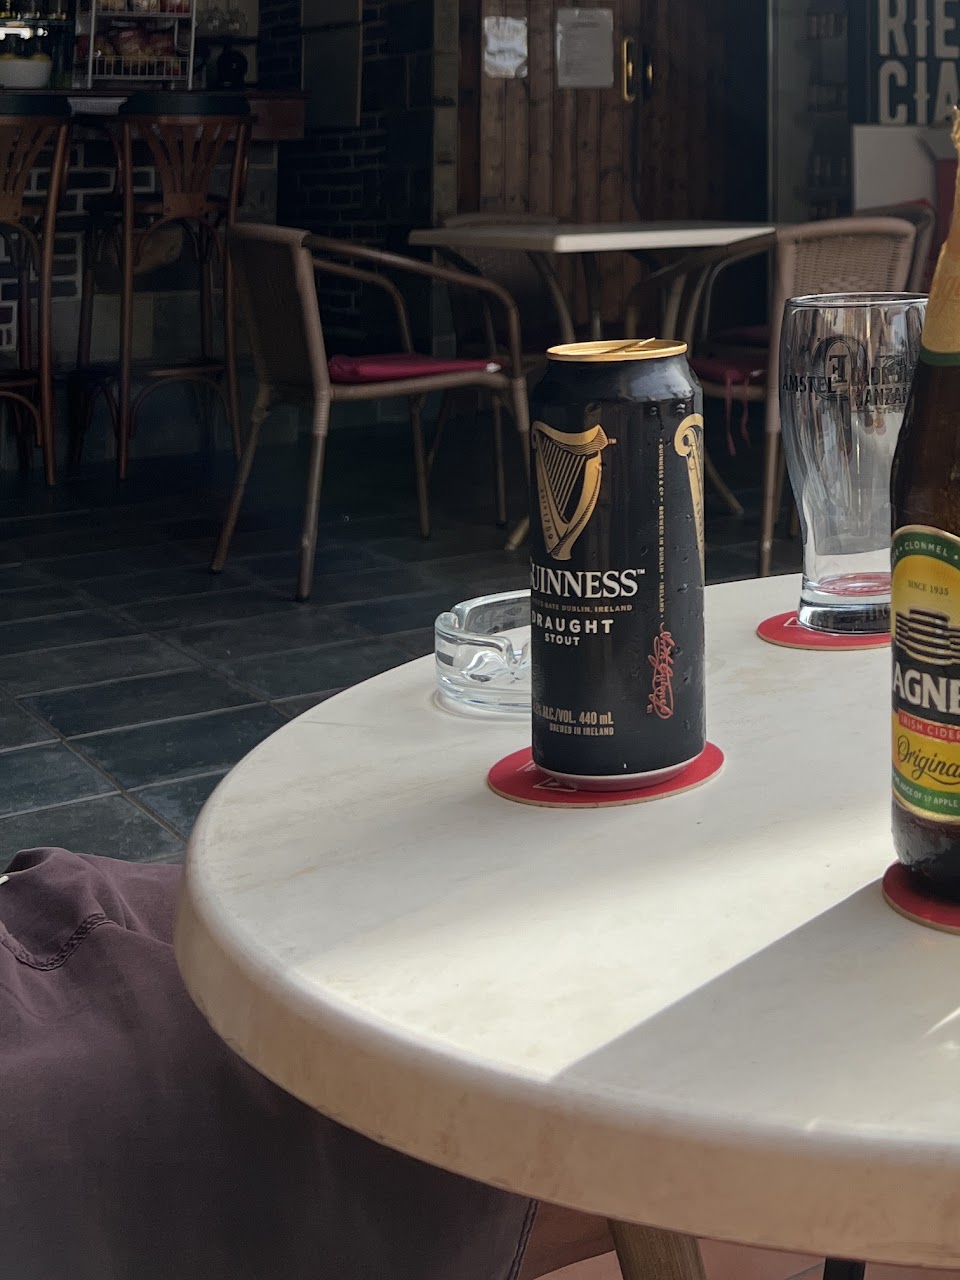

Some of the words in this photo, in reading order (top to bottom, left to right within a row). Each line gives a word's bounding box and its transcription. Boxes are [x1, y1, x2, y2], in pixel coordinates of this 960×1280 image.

[783, 374, 836, 394] AMSTEL
[904, 540, 948, 557] CLONMEL
[530, 558, 638, 598] UINNESS
[908, 580, 926, 593] SINCE
[930, 584, 949, 596] 1935
[594, 604, 633, 613] IRELAND
[531, 610, 614, 634] DRAUGHT
[545, 632, 580, 646] STOUT
[579, 711, 597, 725] 440
[901, 714, 923, 730] IRISH
[549, 723, 573, 735] BREWED
[583, 726, 615, 736] IRELAND
[933, 797, 959, 808] APPLE
